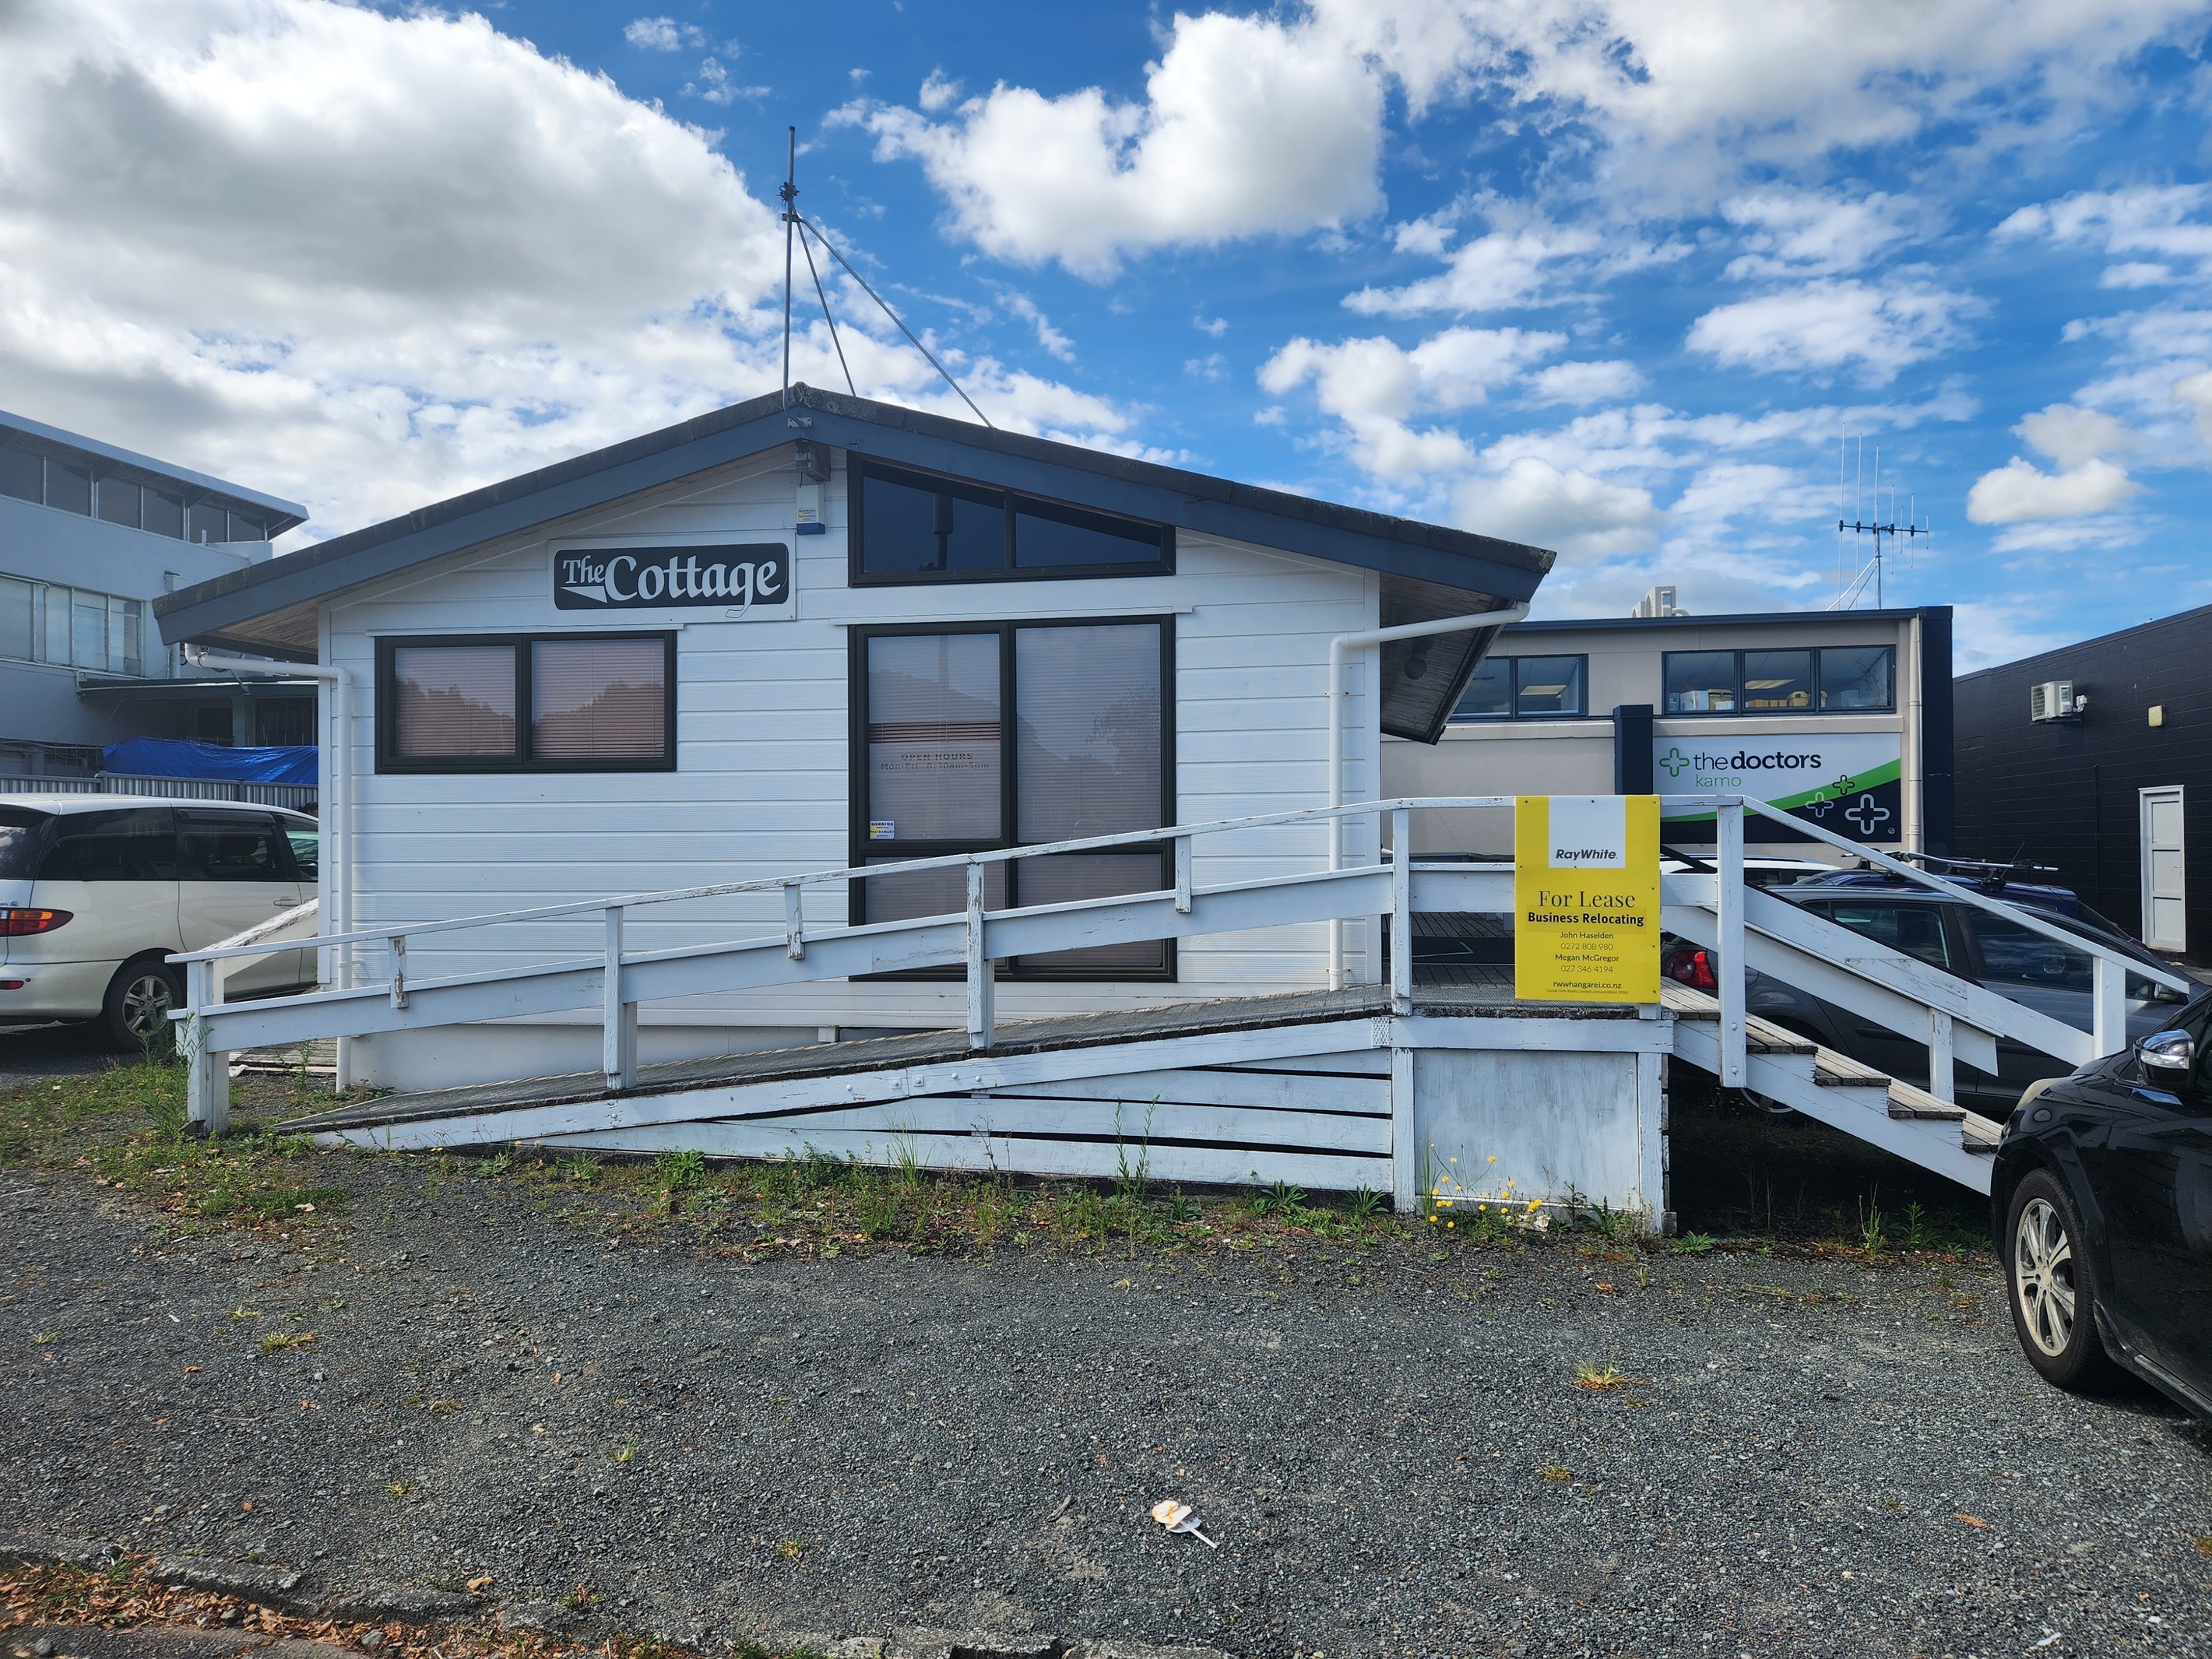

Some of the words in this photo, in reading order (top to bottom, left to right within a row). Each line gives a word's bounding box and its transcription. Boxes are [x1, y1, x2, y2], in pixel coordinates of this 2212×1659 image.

[562, 554, 605, 584] The
[604, 555, 780, 618] Cottage
[1693, 752, 1728, 770] the
[1730, 750, 1822, 770] doctors
[1696, 774, 1742, 788] kamo
[1539, 891, 1573, 908] For
[1579, 891, 1637, 909] Lease
[1528, 912, 1579, 923] Business
[1582, 913, 1644, 927] Relocating
[1555, 954, 1581, 962] Megan
[1582, 954, 1620, 963] McGregor
[1553, 981, 1622, 989] rwwhangarei.co.nz
